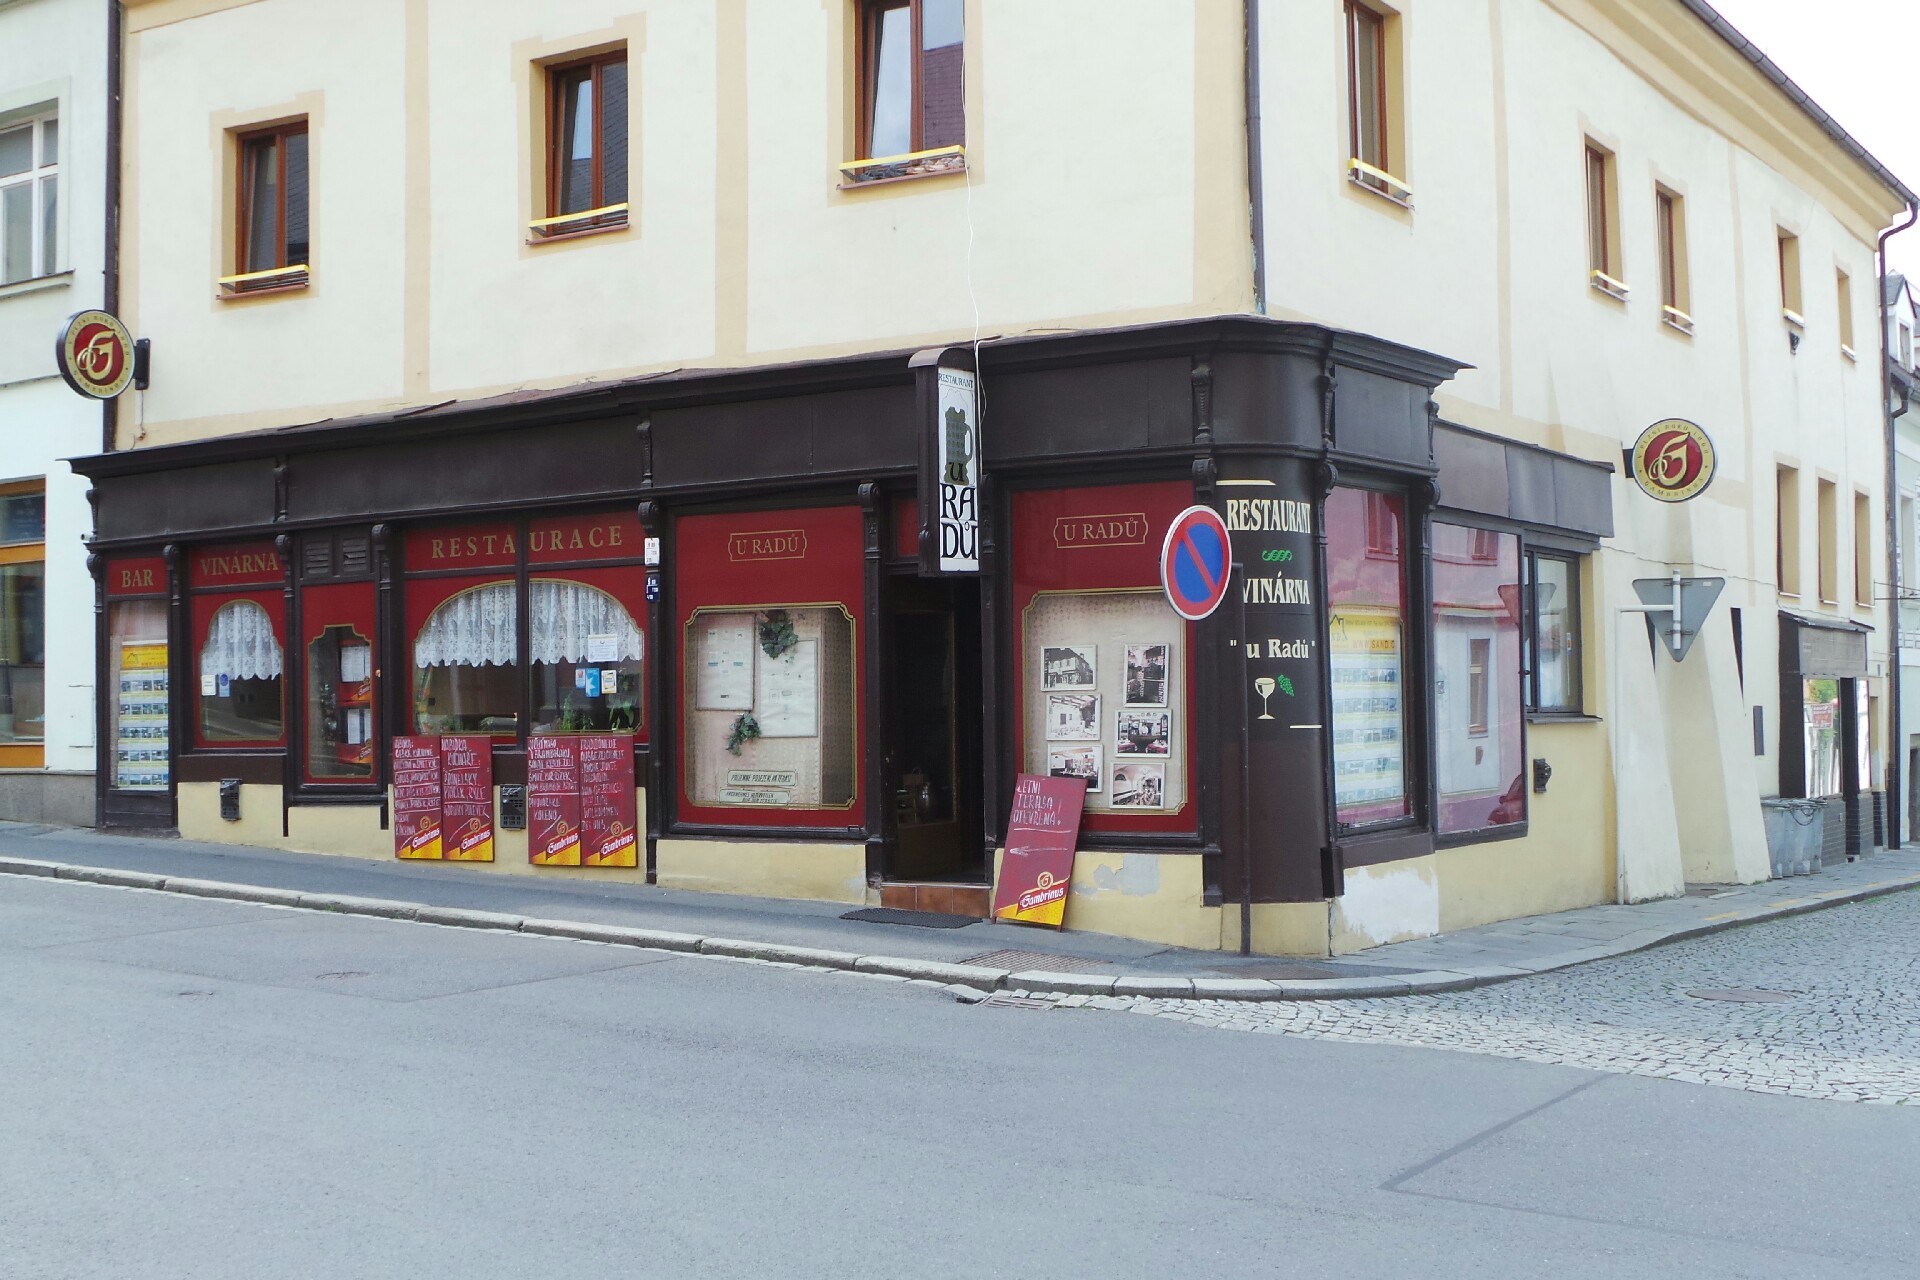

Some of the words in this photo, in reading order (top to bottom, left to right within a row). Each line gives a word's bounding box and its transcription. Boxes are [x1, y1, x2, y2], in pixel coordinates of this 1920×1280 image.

[938, 373, 973, 389] RESTAURANT
[1226, 499, 1311, 534] RESTAURANT
[1063, 525, 1077, 541] U
[1082, 517, 1140, 540] RADŮ
[432, 525, 622, 559] RESTAURACE
[736, 540, 751, 556] U
[752, 533, 799, 554] RADŮ
[200, 551, 280, 576] VINÁRNA
[121, 569, 154, 588] BAR
[1243, 570, 1311, 605] VINÁRNA
[1020, 887, 1064, 908] Gambrinus
